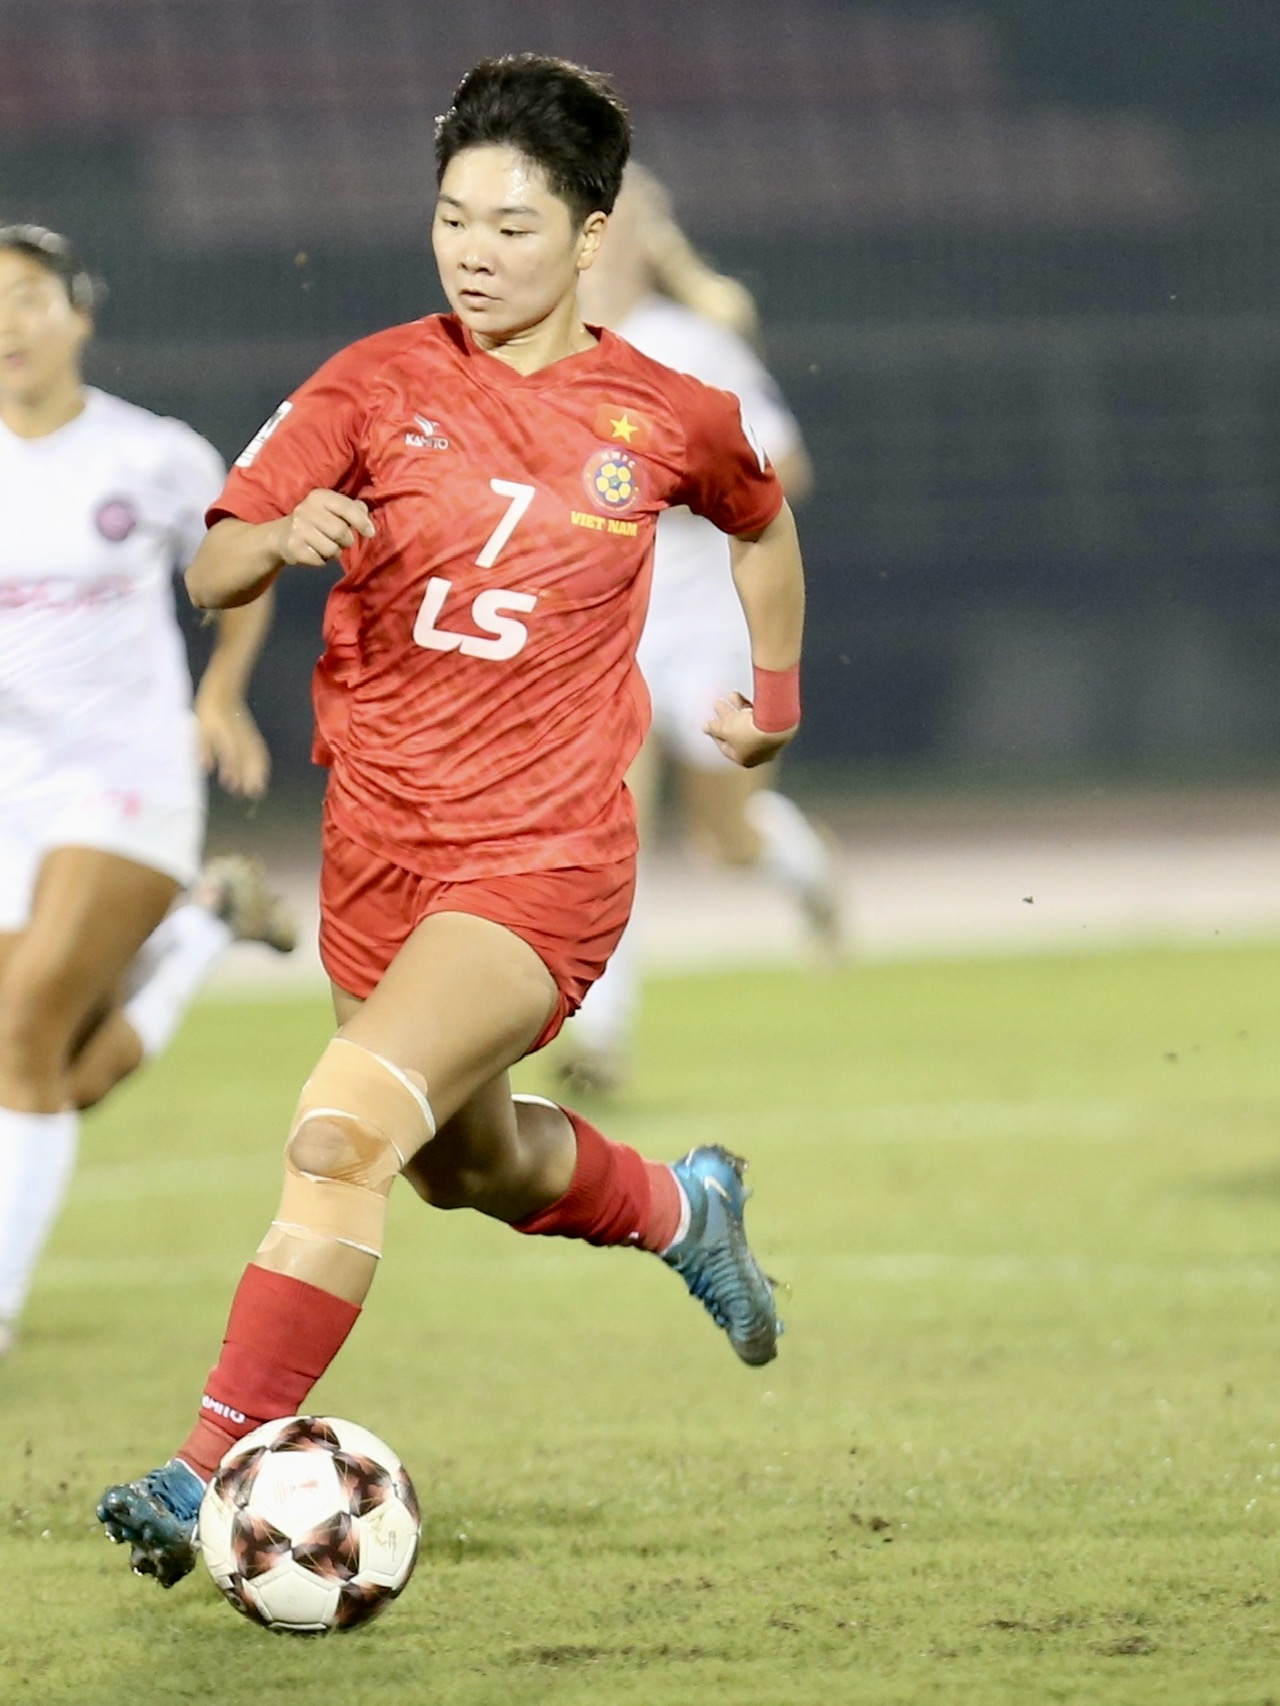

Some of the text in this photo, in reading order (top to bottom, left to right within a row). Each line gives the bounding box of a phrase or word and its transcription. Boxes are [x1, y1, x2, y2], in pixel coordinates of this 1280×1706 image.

[475, 477, 536, 569] 7
[571, 511, 638, 536] VIET NAM
[413, 576, 538, 661] LS
